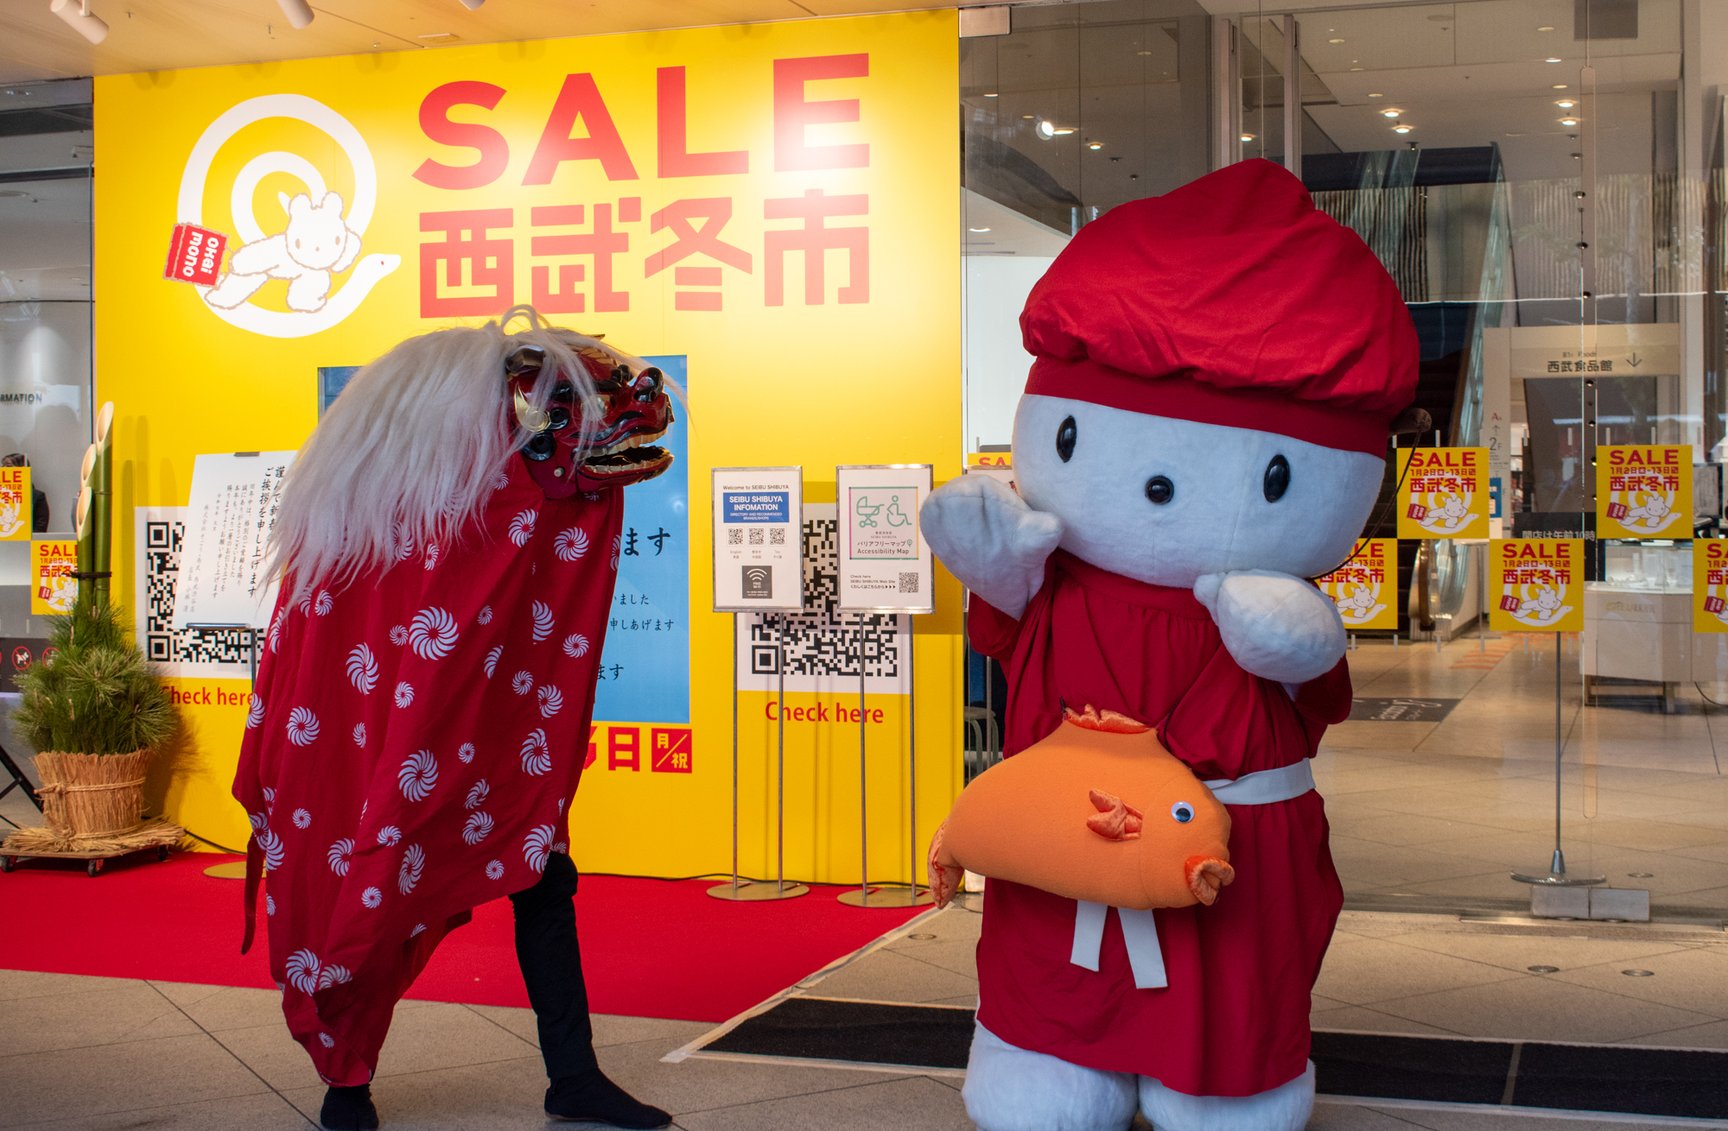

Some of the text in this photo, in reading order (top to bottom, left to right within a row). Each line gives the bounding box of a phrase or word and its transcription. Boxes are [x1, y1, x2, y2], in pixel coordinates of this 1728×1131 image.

[411, 53, 870, 190] SALE
[182, 231, 203, 277] mono
[419, 188, 870, 319] 西武冬市
[1547, 360, 1613, 373] 西武食品館
[978, 456, 1006, 466] SA
[1410, 451, 1476, 467] SALE
[1609, 449, 1679, 465] SALE
[1410, 477, 1477, 493] 西武冬市
[1610, 476, 1679, 492] 西武冬市
[0, 491, 22, 504] 冬市
[751, 495, 783, 503] SHIBUYA
[733, 503, 779, 511] INFOMATION
[623, 526, 672, 557] ます
[1348, 543, 1384, 558] LE
[1502, 543, 1571, 558] SALE
[40, 565, 78, 578] 西武冬
[1503, 569, 1571, 585] 西武冬市
[1707, 569, 1728, 585] 西
[614, 593, 649, 606] ました
[610, 617, 674, 632] 申しあげます
[765, 701, 884, 723] Check here
